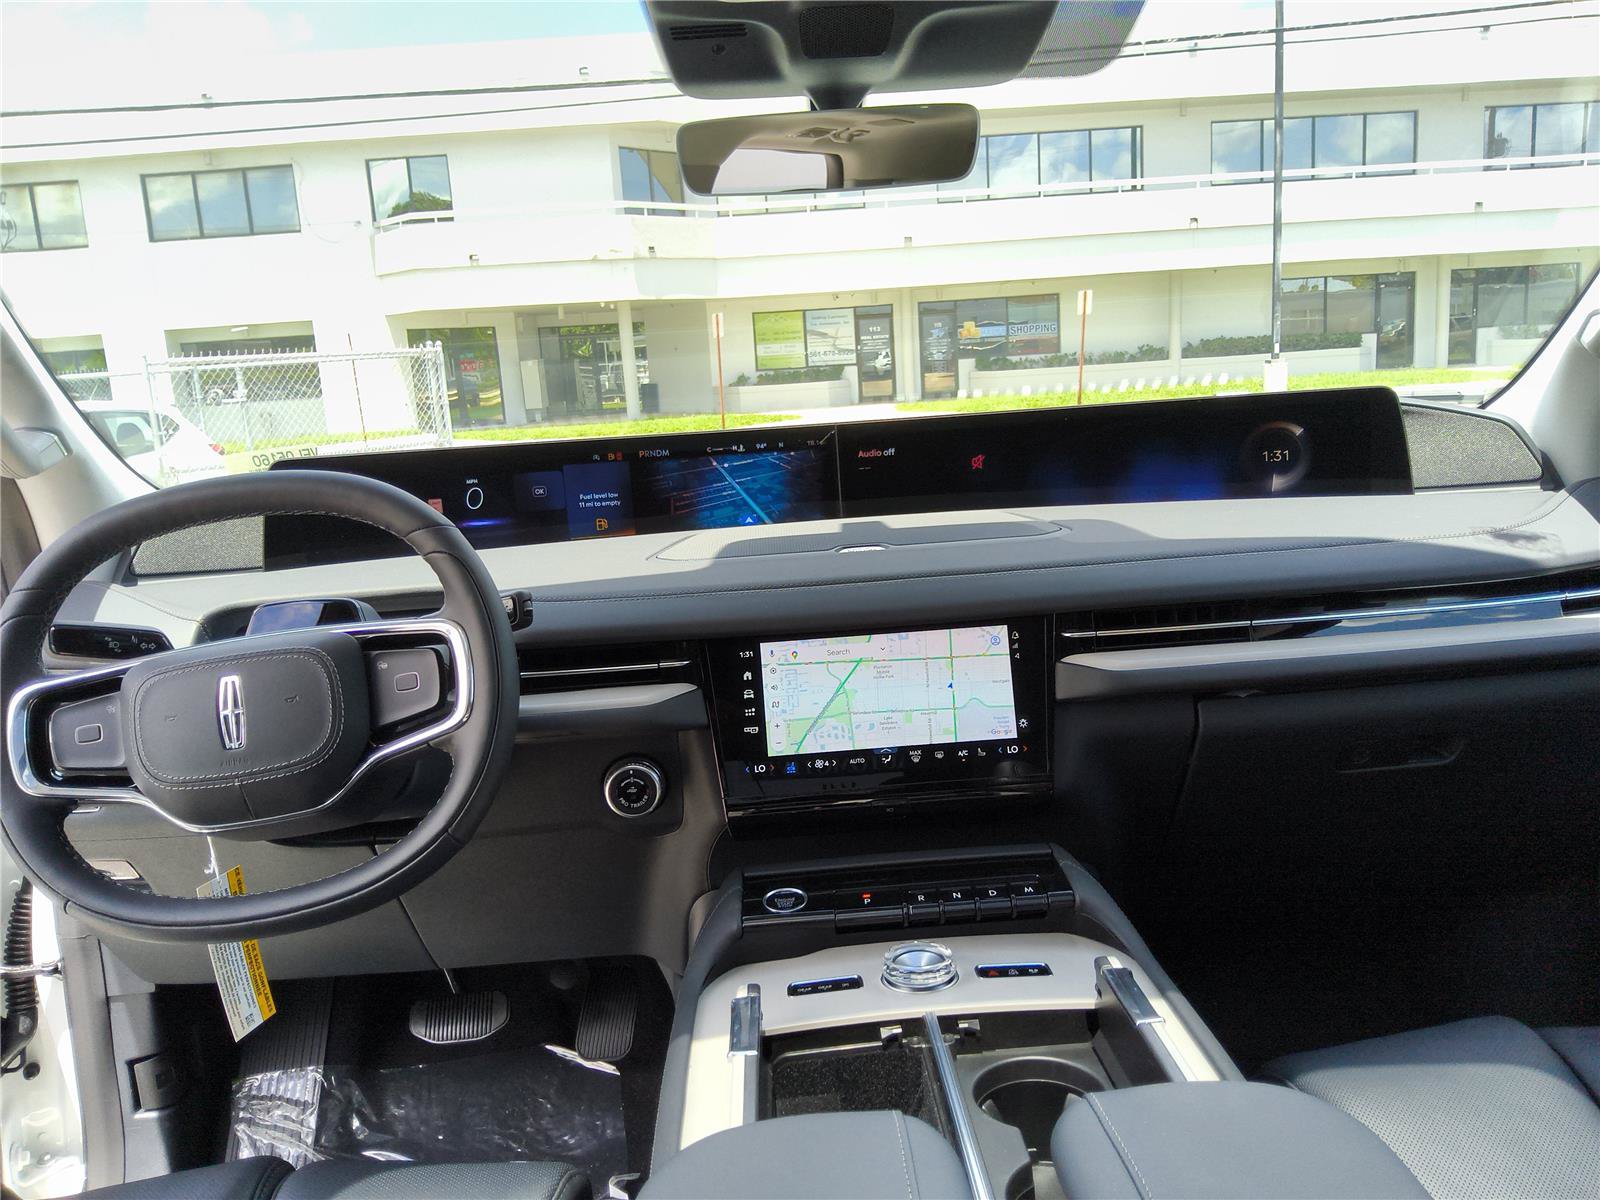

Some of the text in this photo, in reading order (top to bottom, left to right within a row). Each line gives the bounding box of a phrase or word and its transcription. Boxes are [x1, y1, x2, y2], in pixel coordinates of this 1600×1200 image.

[1010, 323, 1056, 335] SHOPPING
[858, 448, 895, 458] Audio off
[1262, 450, 1289, 462] 1:31
[602, 500, 621, 508] empty
[826, 648, 851, 657] Search
[1006, 745, 1019, 754] LO
[754, 764, 766, 773] LO
